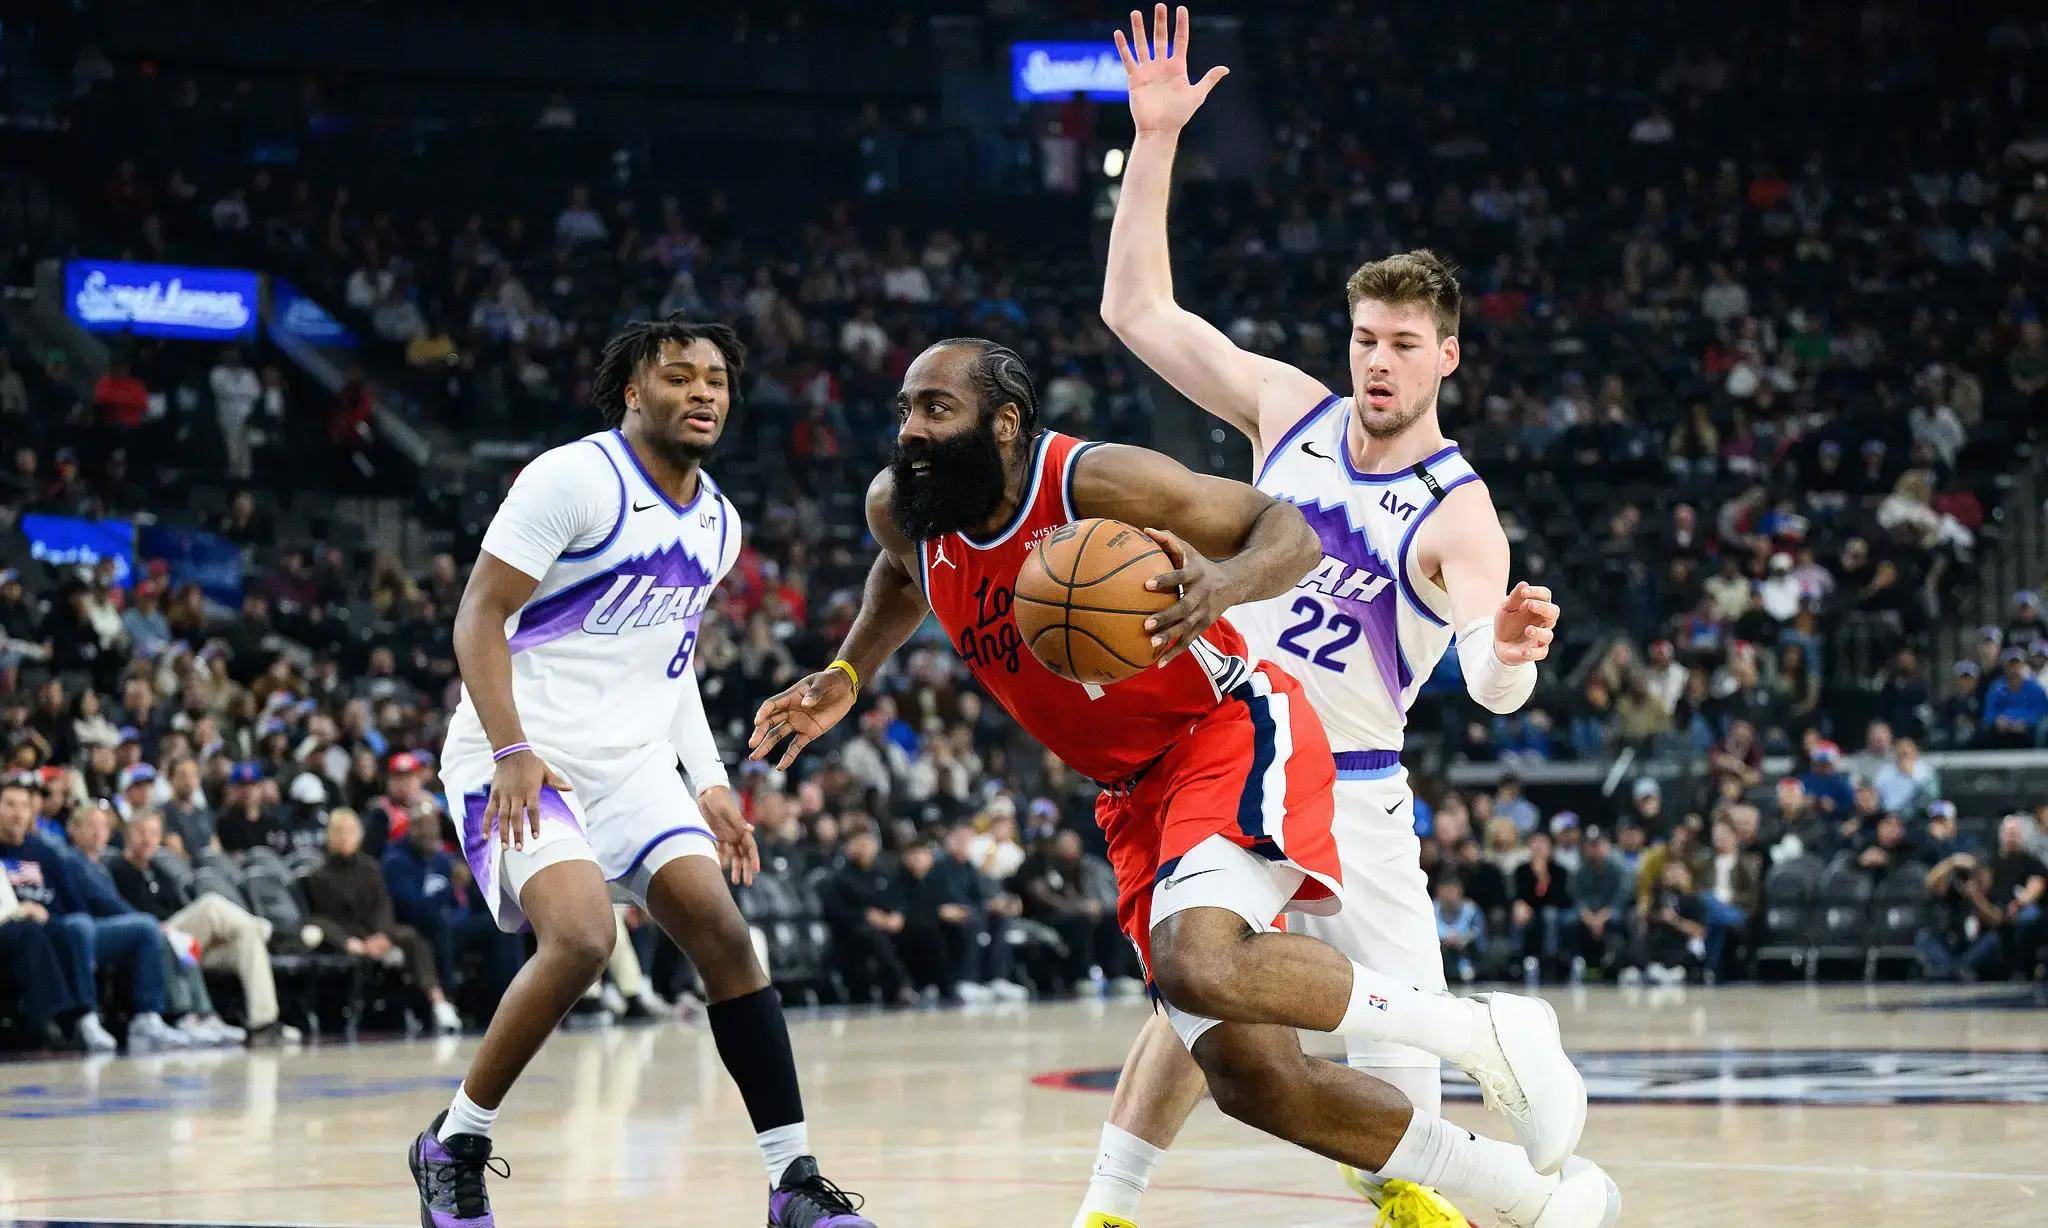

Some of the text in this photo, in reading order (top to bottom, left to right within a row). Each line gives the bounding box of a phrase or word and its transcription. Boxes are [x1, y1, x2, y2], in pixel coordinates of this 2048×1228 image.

[1032, 524, 1058, 538] VISIT
[972, 576, 1016, 630] Lo
[1296, 554, 1394, 603] AH
[666, 631, 696, 679] 8
[960, 622, 1024, 674] Ang
[1277, 595, 1362, 674] 22
